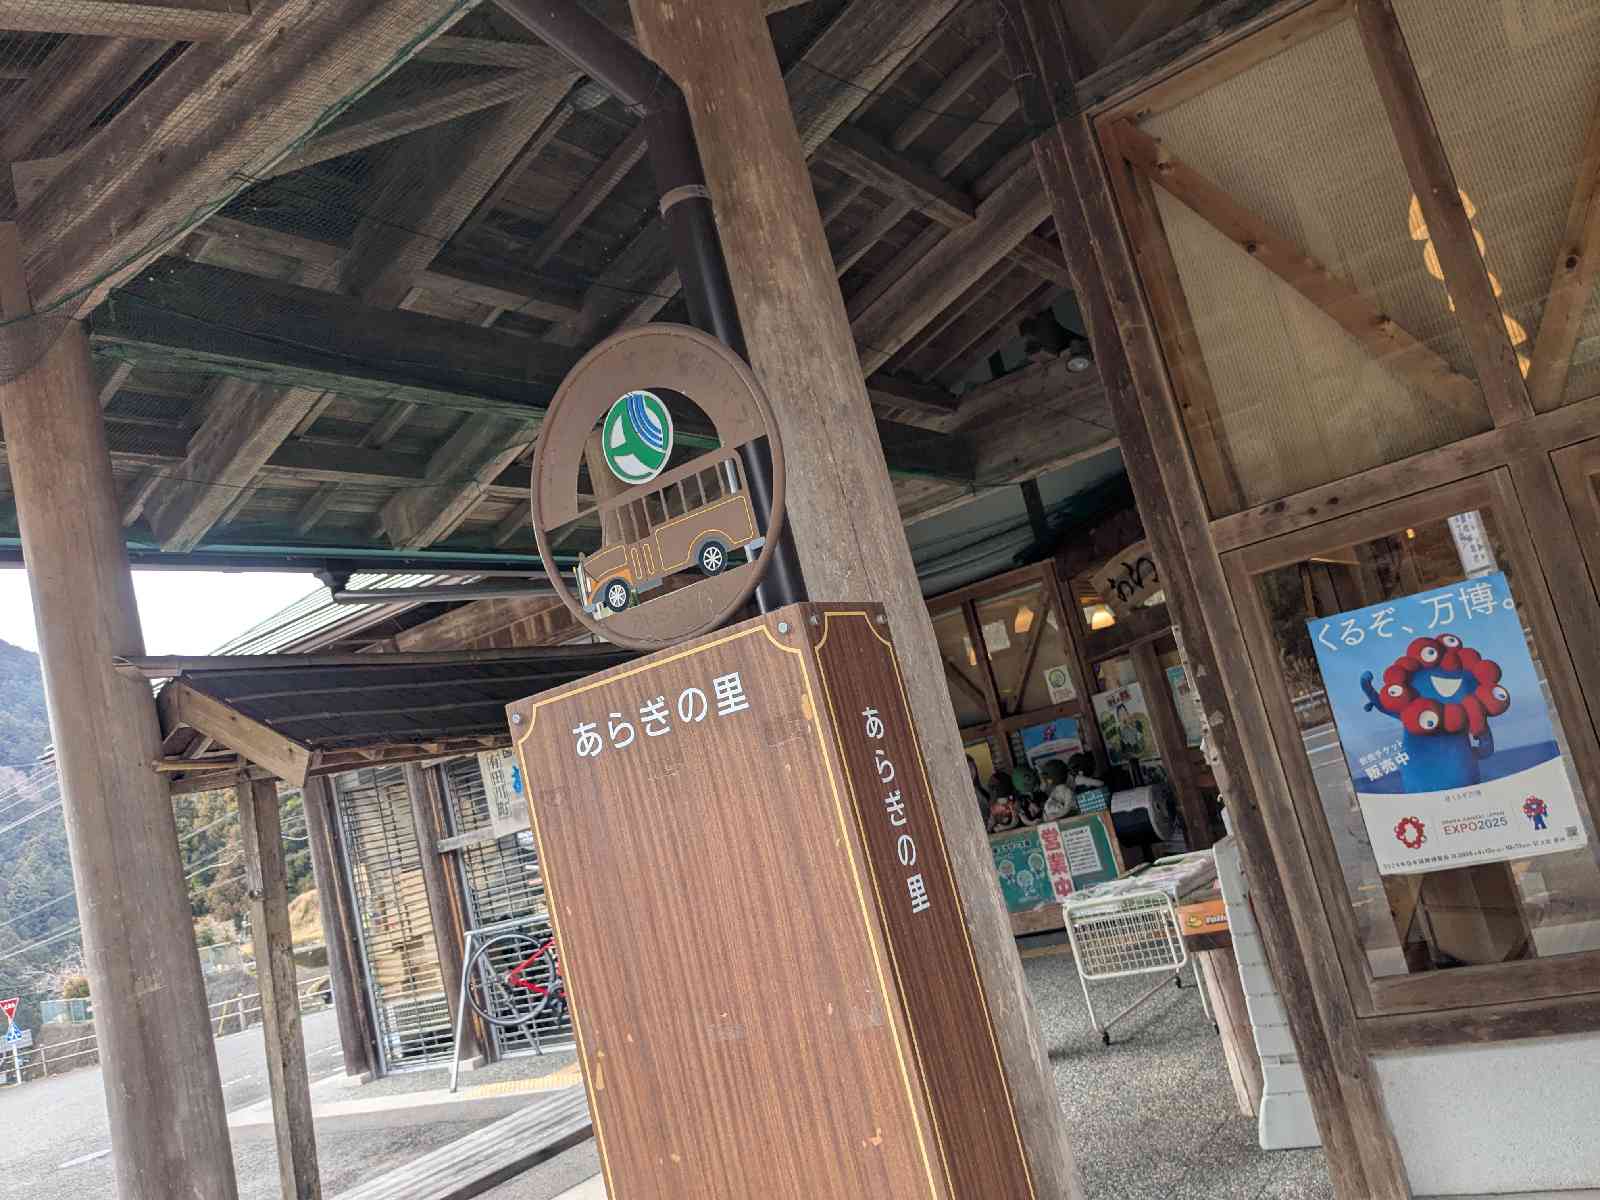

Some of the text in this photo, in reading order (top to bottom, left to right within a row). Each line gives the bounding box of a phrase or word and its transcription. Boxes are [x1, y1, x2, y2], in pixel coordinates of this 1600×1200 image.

[1317, 582, 1515, 651] くるぞ、万博。
[572, 671, 750, 757] あらぎの里
[862, 706, 930, 913] あらぎの里
[1443, 816, 1508, 835] EXPO2025
